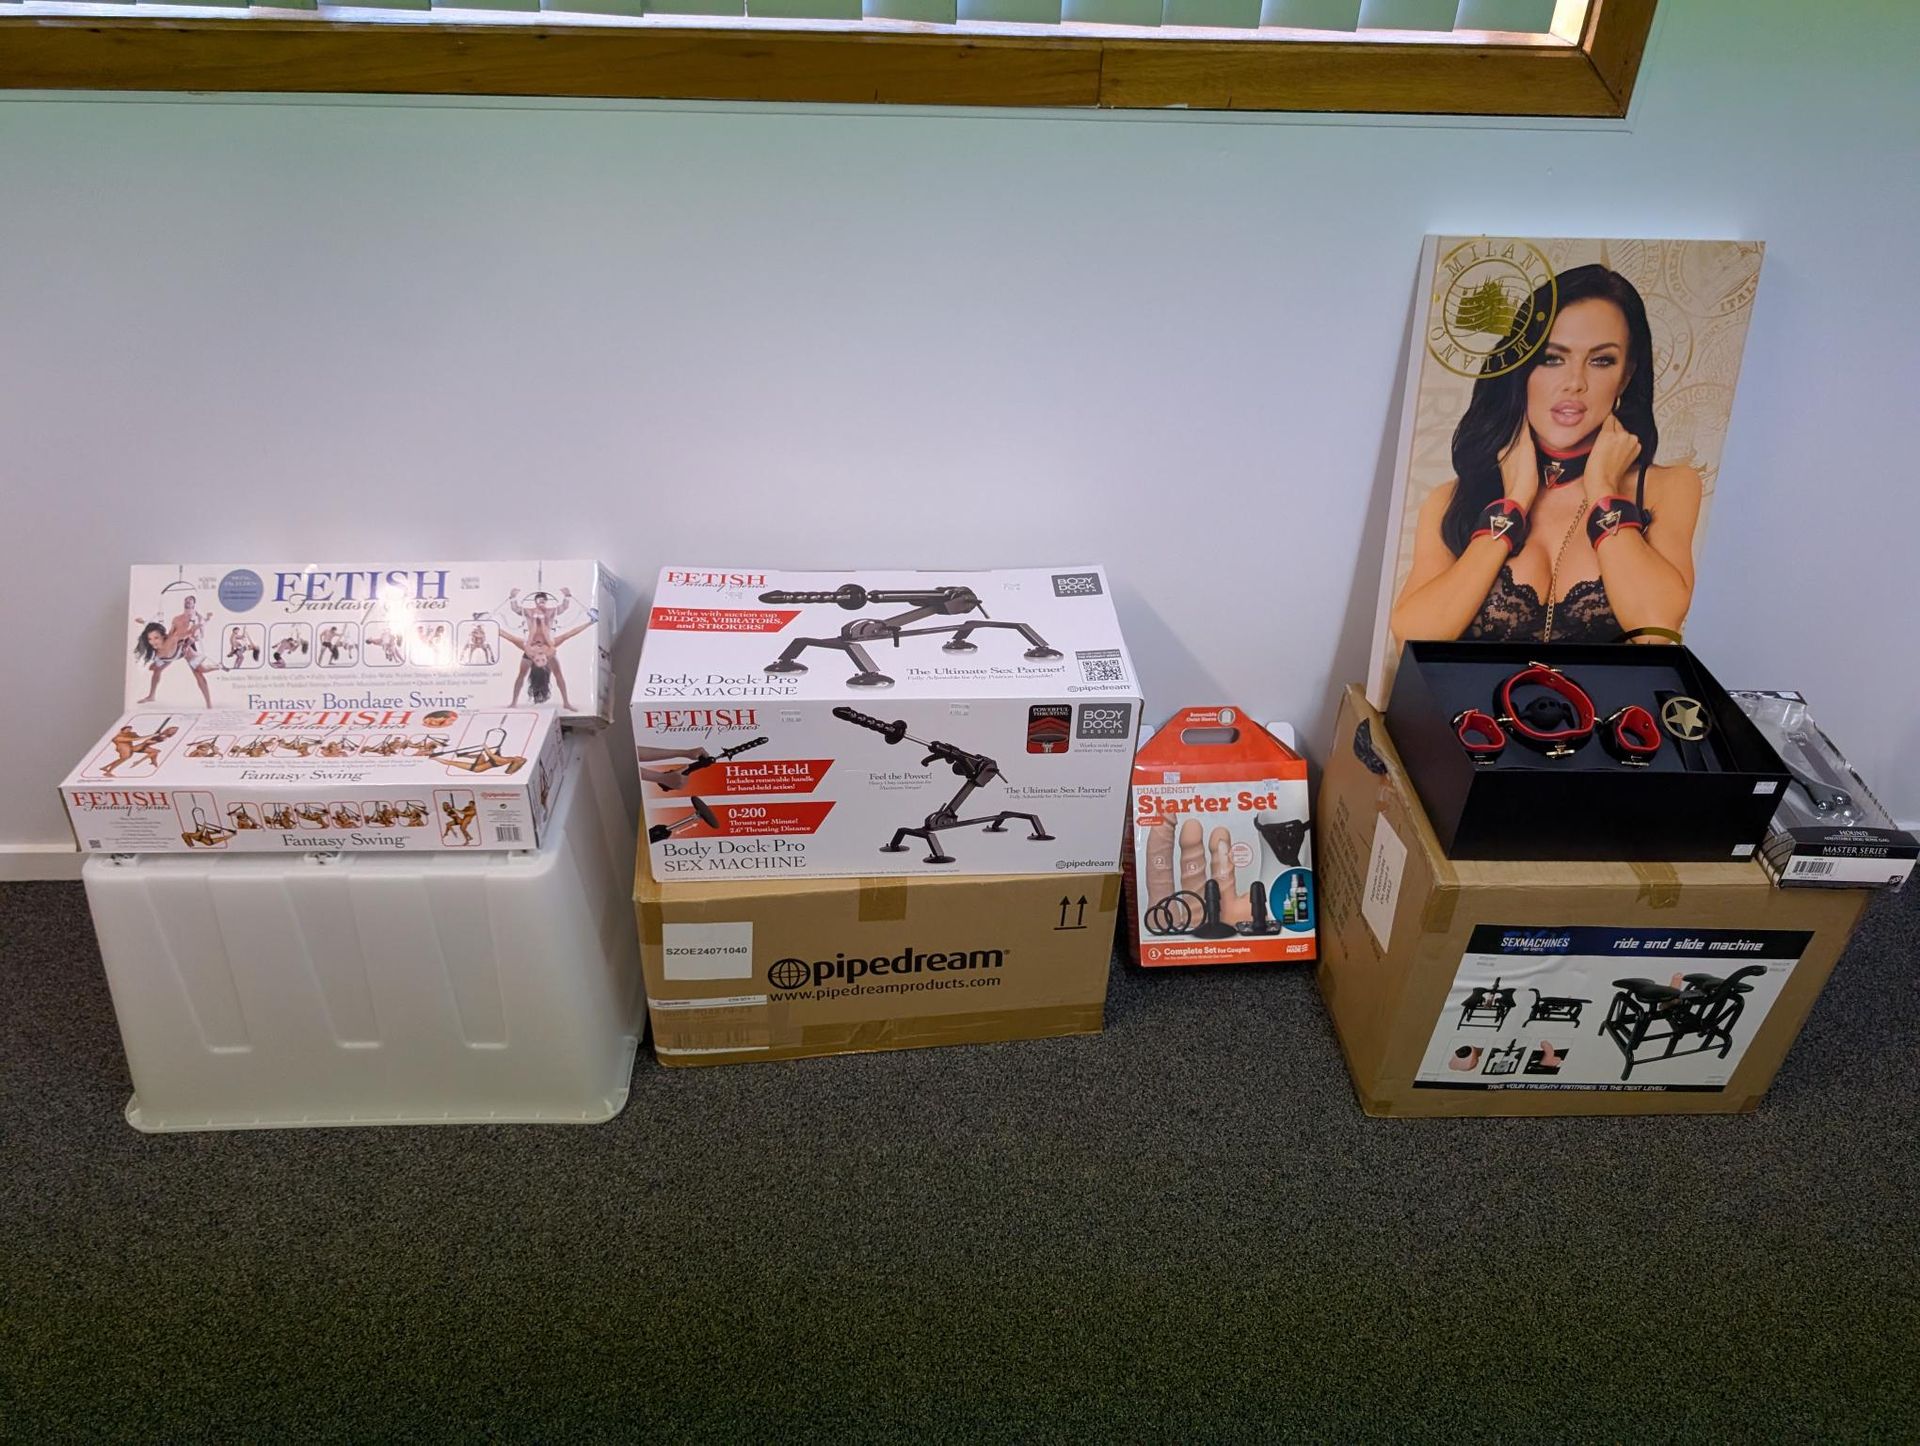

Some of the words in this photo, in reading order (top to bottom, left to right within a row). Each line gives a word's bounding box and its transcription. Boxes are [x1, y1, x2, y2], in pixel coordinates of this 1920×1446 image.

[1447, 241, 1549, 290] MILANO
[1431, 325, 1534, 374] MILANO
[667, 571, 767, 585] FETISH
[272, 570, 451, 602] FETISH
[1058, 583, 1095, 591] DOCK
[284, 593, 376, 625] Fantasy
[658, 615, 709, 623] DILDOS,
[712, 616, 783, 625] VIBRATORS,
[697, 623, 764, 631] STROKERS!
[934, 667, 988, 675] Ultimate
[990, 666, 1013, 674] Sex
[1017, 665, 1066, 674] Partner!
[648, 674, 700, 689] Body
[707, 674, 757, 685] Dock
[766, 675, 798, 684] Pro
[1079, 684, 1129, 692] pipedream
[643, 687, 688, 697] SEX
[692, 687, 798, 697] MACHINE
[248, 694, 317, 710] Fantasy
[323, 691, 403, 710] Bondage
[409, 691, 468, 710] Swing
[253, 711, 415, 728] FETISH
[644, 709, 758, 729] FETISH
[1083, 709, 1124, 720] BODY
[655, 722, 714, 739] Fantasy
[718, 722, 760, 734] Series
[1082, 720, 1123, 729] DOCK
[239, 770, 305, 783] Fantasy
[309, 769, 363, 782] Swing
[725, 763, 809, 777] Hand-Held
[888, 772, 902, 780] the
[904, 772, 932, 780] Power!
[755, 776, 791, 784] removable
[1022, 786, 1058, 794] Ultimate
[1078, 785, 1112, 793] Partner!
[1136, 786, 1160, 796] DUAL
[1161, 786, 1196, 795] DENSITY
[71, 791, 170, 807] FETISH
[1137, 794, 1231, 815] Starter
[1237, 791, 1278, 813] Set
[728, 807, 767, 819] 0-200
[745, 826, 779, 834] Thrusting
[281, 833, 353, 850] Fantasy
[351, 833, 405, 850] Swing
[663, 841, 712, 860] Body
[718, 839, 768, 855] Dock
[774, 840, 805, 852] Pro
[1822, 846, 1857, 855] MASTER
[1859, 847, 1889, 856] SERIES
[664, 859, 703, 874] SEX
[708, 856, 807, 872] MACHINE
[1066, 859, 1115, 870] pipedream
[1501, 937, 1571, 948] SEXMACHINES
[1612, 938, 1639, 950] ride
[1643, 938, 1672, 950] and
[1673, 938, 1706, 951] slide
[1708, 939, 1764, 952] machine
[666, 947, 747, 956] SZOE24071040
[1164, 947, 1203, 957] Complete
[1204, 946, 1217, 954] Set
[1226, 946, 1250, 954] Couples
[813, 947, 1004, 987] pipedream
[769, 976, 1001, 1002] www.pipedreamproducts.com
